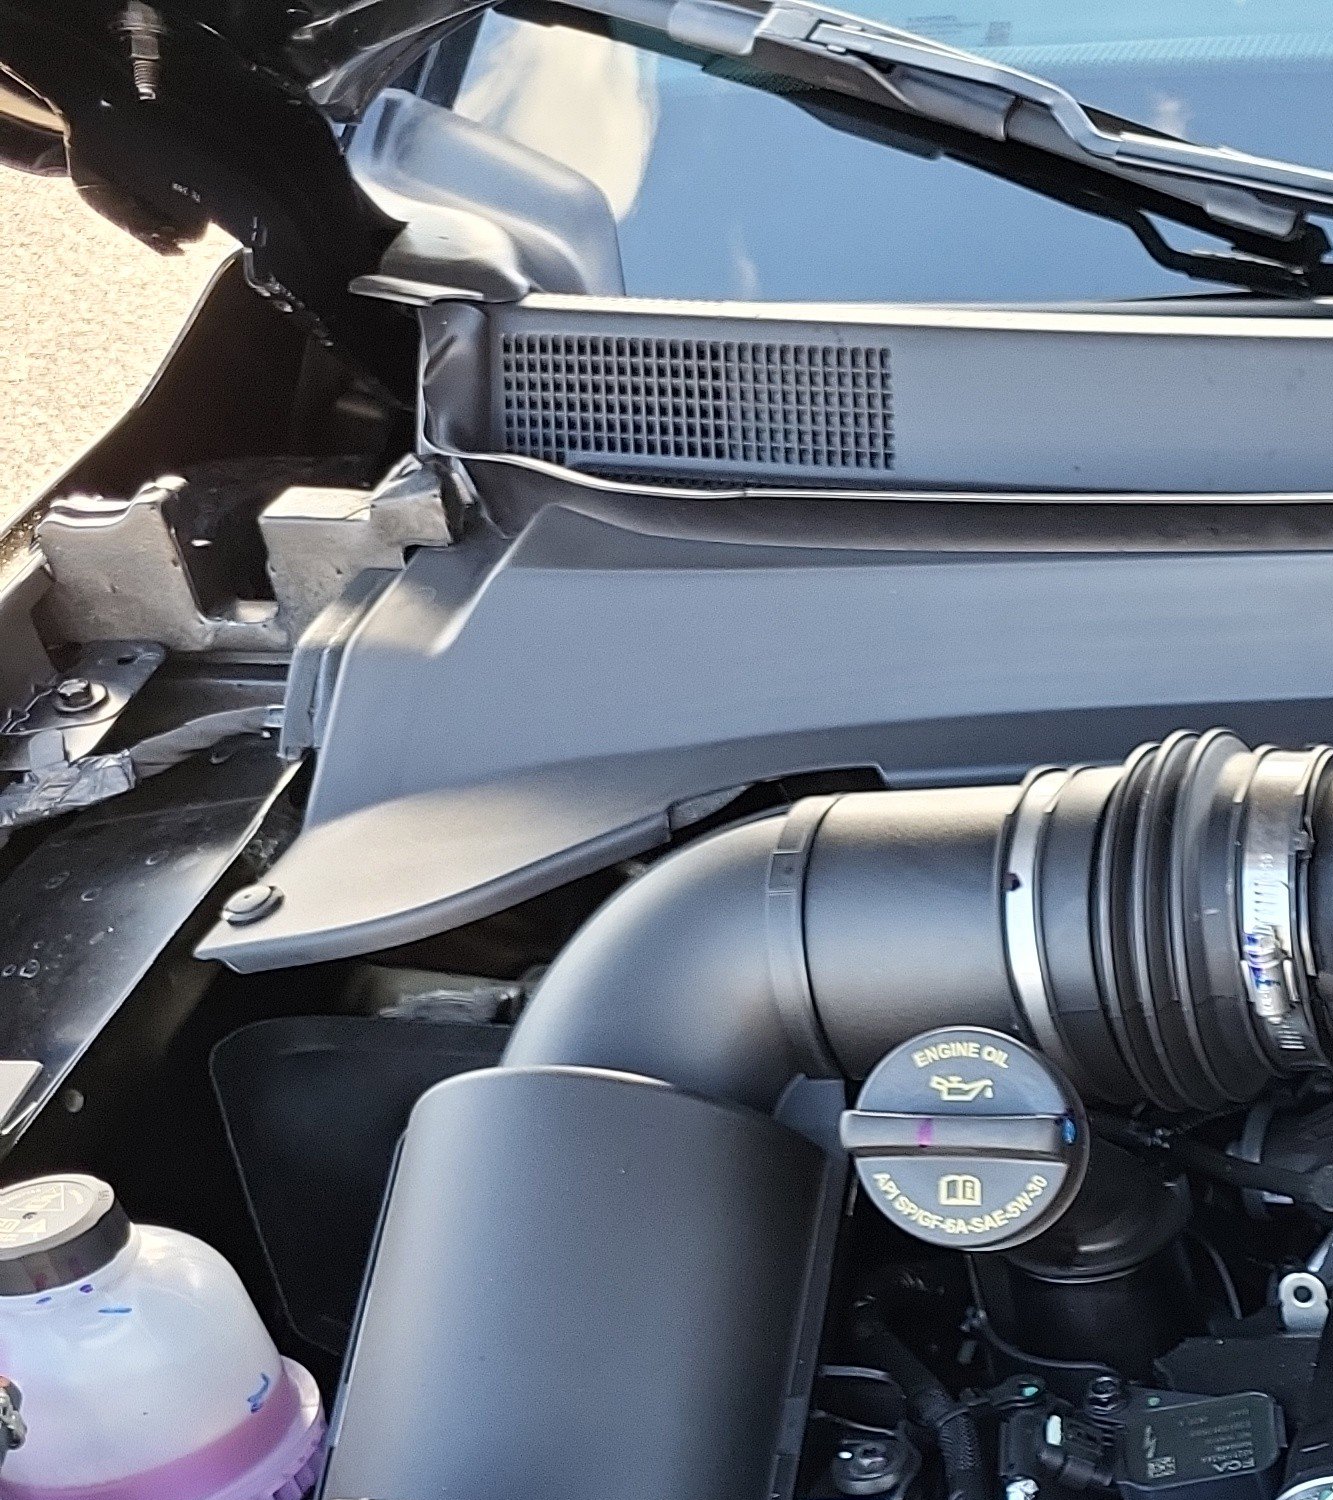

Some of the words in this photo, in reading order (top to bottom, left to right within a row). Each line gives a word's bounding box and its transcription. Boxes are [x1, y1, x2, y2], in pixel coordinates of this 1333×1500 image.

[912, 1042, 980, 1068] ENGINE
[981, 1046, 1009, 1069] OIL
[873, 1172, 901, 1200] API
[1213, 1457, 1255, 1473] FCA
